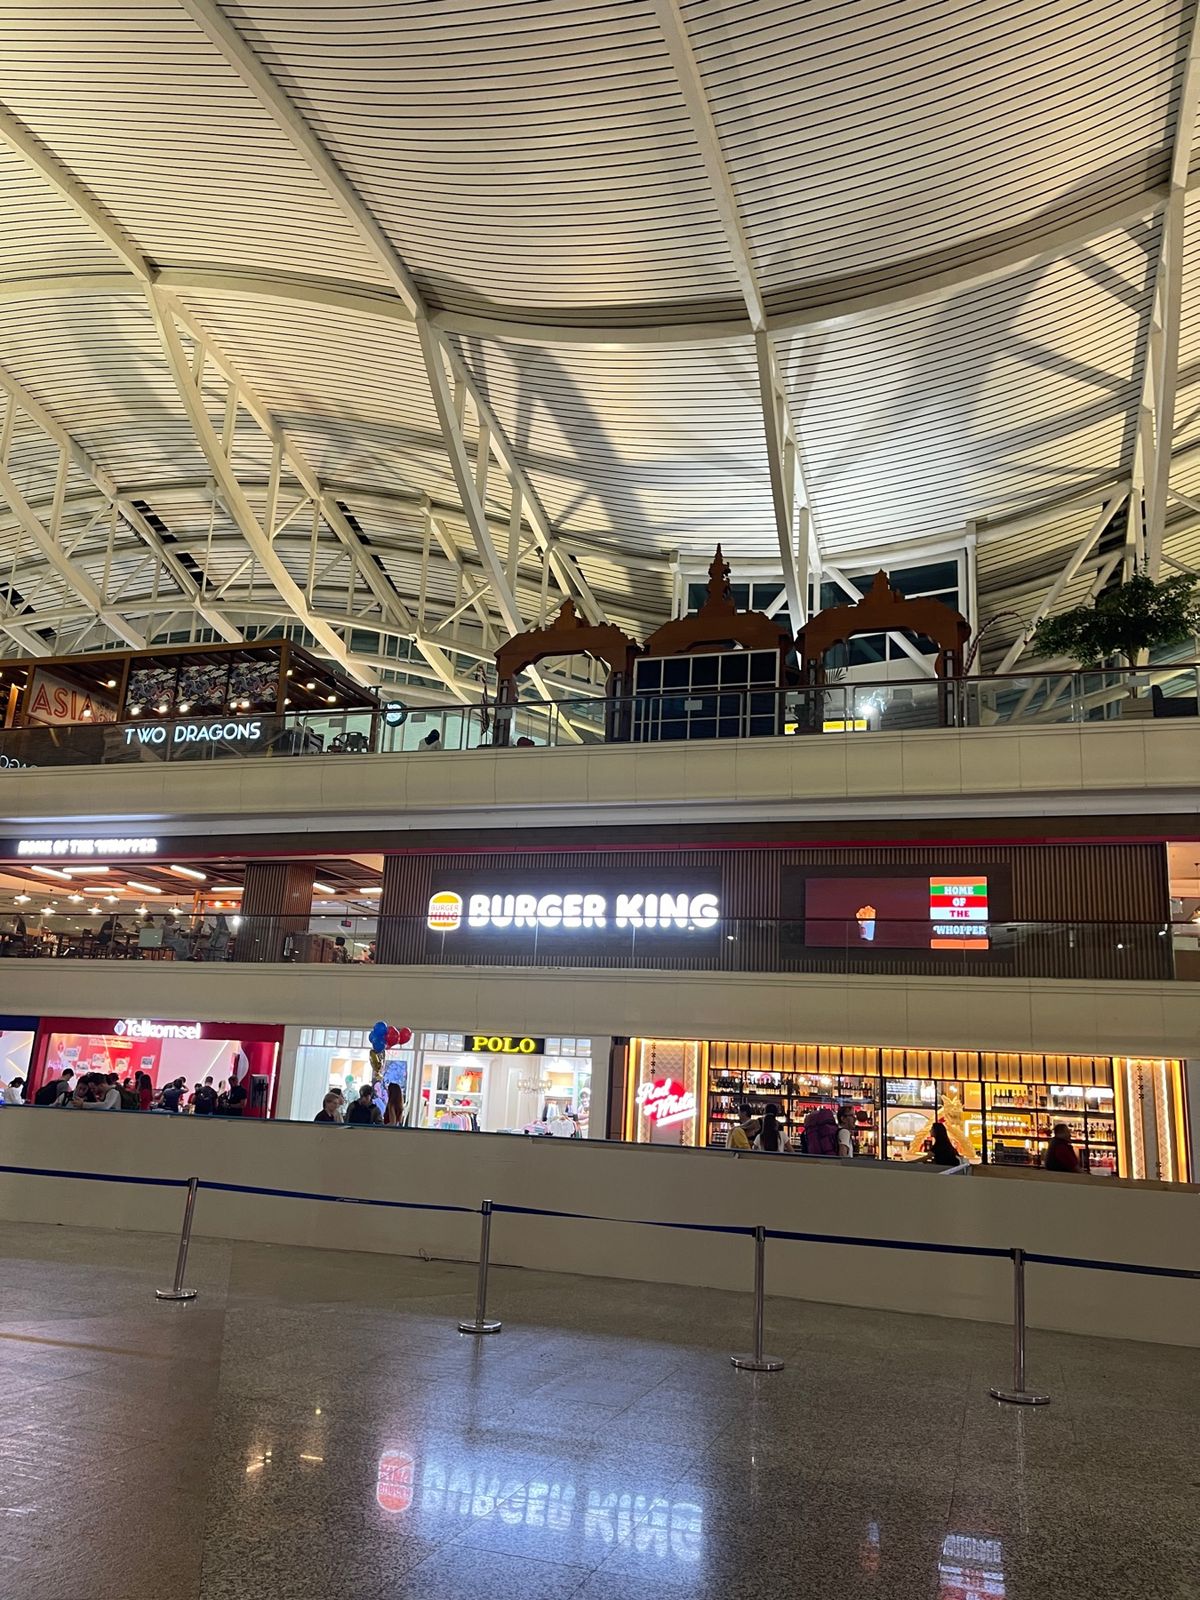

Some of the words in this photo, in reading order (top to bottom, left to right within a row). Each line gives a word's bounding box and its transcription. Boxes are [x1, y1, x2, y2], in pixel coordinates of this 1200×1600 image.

[31, 683, 97, 721] ASIA
[125, 727, 166, 744] TWO
[174, 722, 261, 742] DRAGONS
[944, 886, 974, 895] HOME
[468, 894, 606, 927] BURGER
[616, 894, 719, 928] KING
[952, 897, 966, 907] OF
[933, 925, 987, 935] WHOPPER
[125, 1019, 201, 1039] Telkomsel
[472, 1036, 535, 1053] POLO
[636, 1078, 672, 1104] Red
